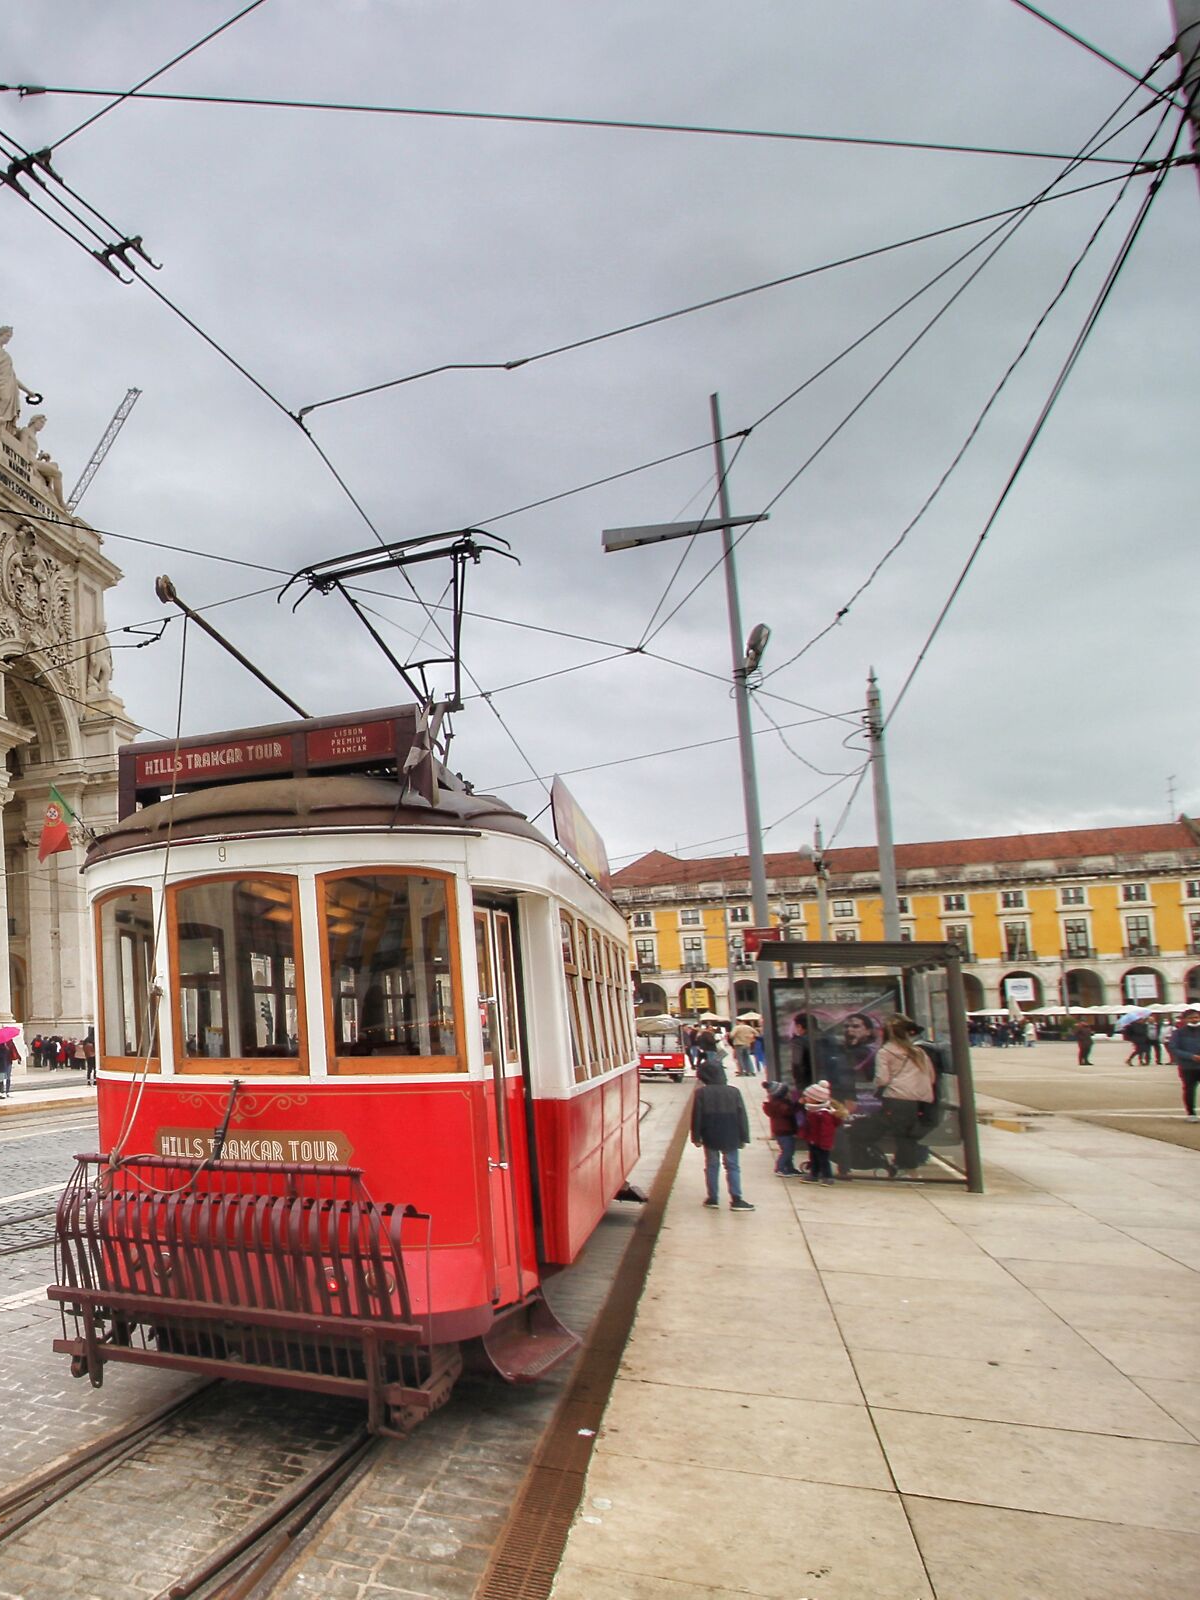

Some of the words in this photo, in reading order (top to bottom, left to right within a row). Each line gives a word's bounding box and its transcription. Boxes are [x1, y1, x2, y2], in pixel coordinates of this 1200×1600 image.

[334, 727, 363, 738] LISBON
[331, 736, 367, 747] PREMIUM
[332, 744, 367, 755] TRAMCAR
[144, 756, 183, 776] HILLS
[186, 748, 243, 770] TRAMCAR
[246, 742, 283, 761] TOUR
[161, 1135, 204, 1158] HILLS
[207, 1138, 284, 1161] TRAMCAR
[288, 1140, 339, 1162] TOUR
